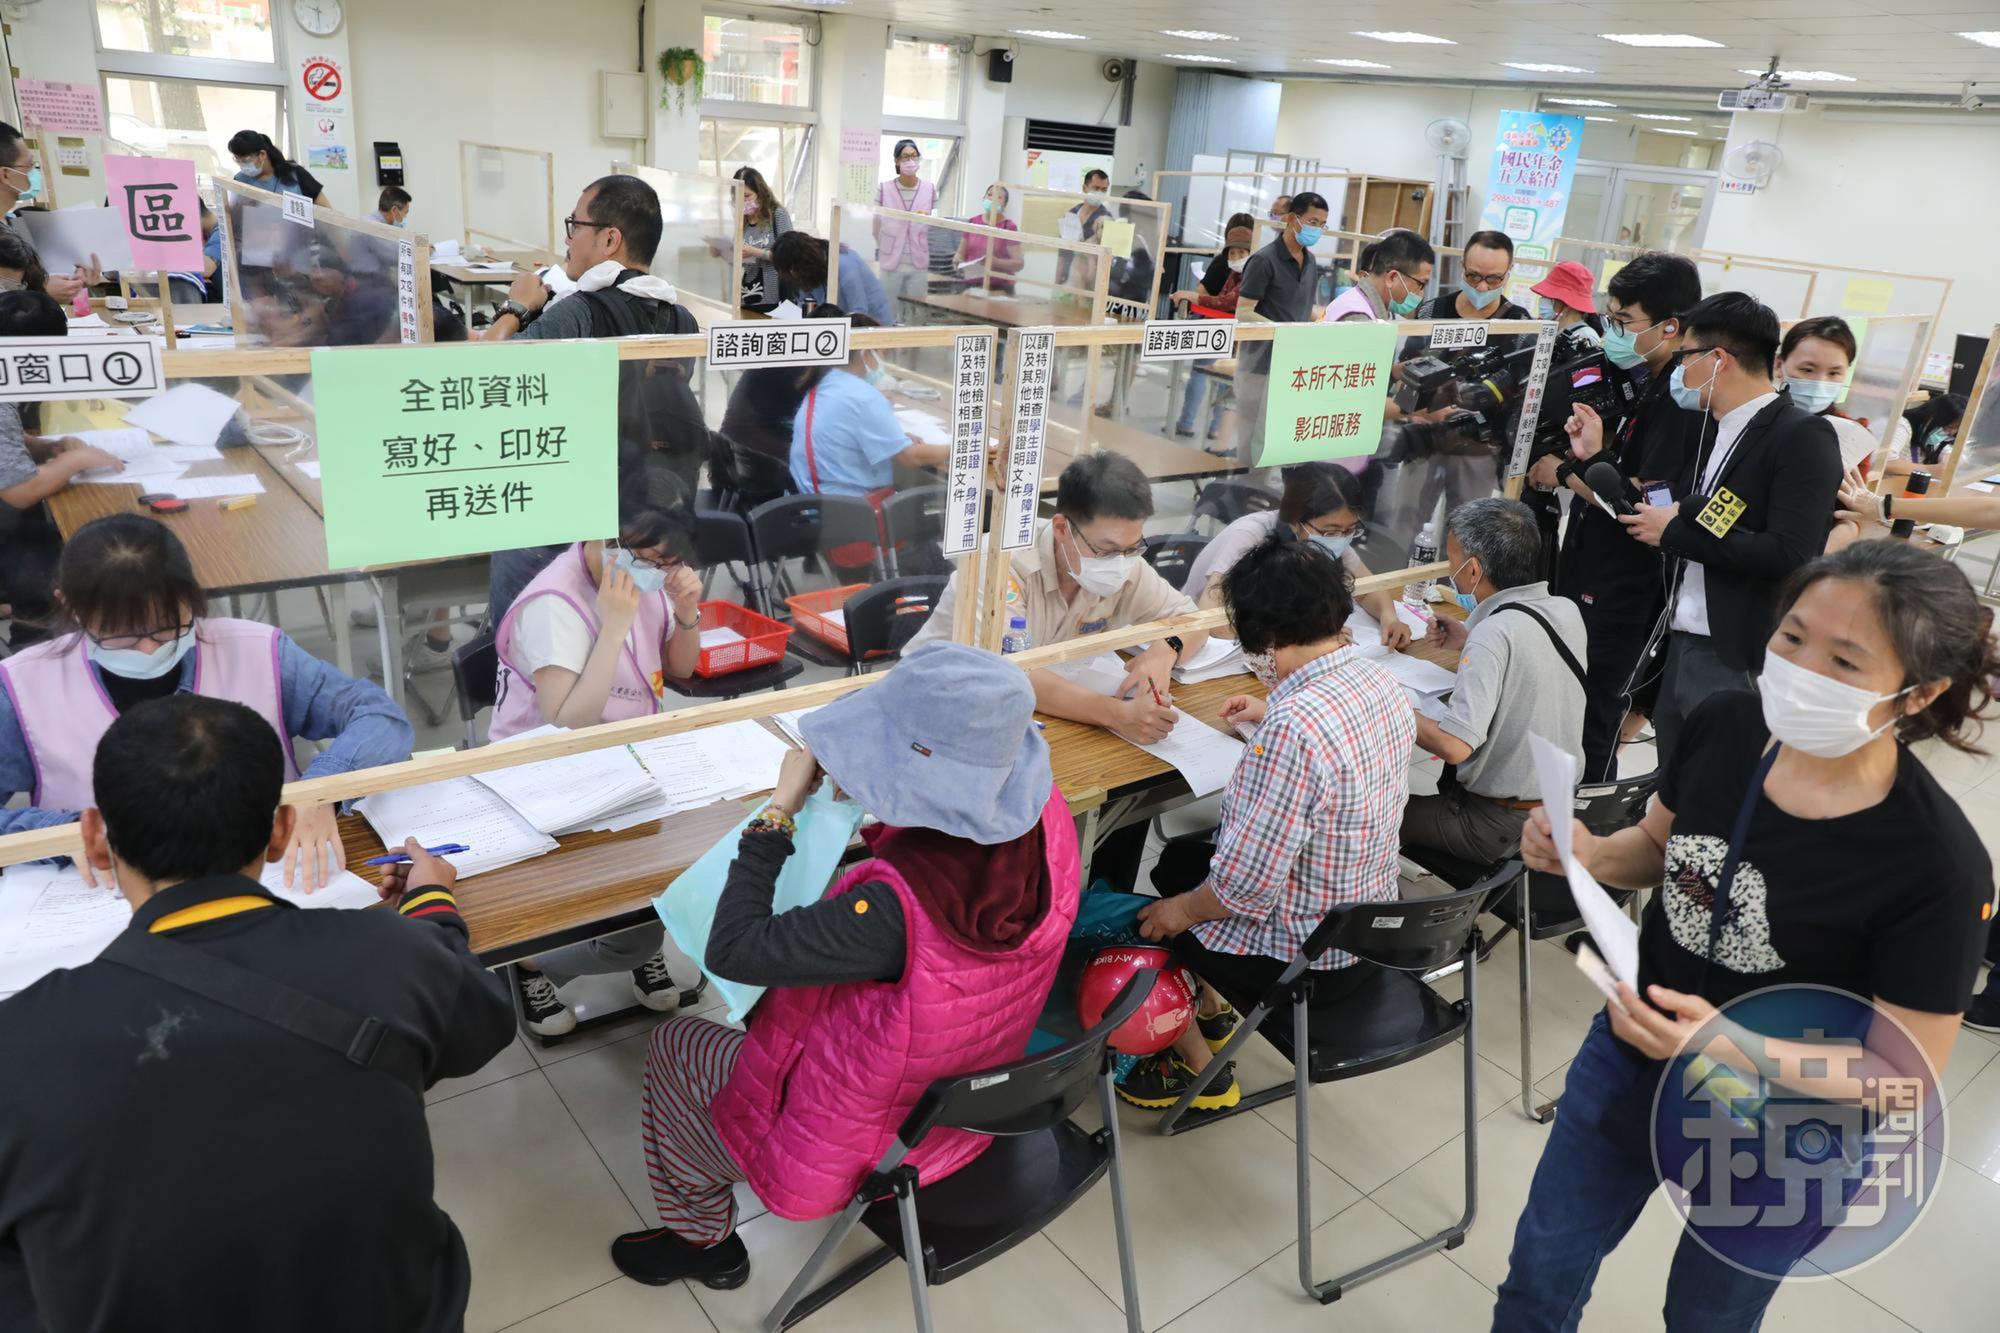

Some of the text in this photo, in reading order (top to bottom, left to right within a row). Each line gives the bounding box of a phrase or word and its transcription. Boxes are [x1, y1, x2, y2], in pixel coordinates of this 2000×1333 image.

[1499, 169, 1559, 188] 五大給付
[1500, 150, 1562, 171] 國民年金
[124, 183, 192, 242] 區
[400, 374, 550, 413] 全部資料
[1291, 362, 1377, 392] 本所不提供
[953, 338, 973, 503] 以及其他相關證明文件
[1011, 335, 1036, 500] 以及其他相關證明文件
[1294, 411, 1361, 443] 影印服務
[382, 426, 568, 470] 寫好、印好
[962, 338, 987, 548] 請特別檢查學生證、身障手冊
[1018, 335, 1049, 545] 請特別檢查學生證、身障手冊
[425, 481, 534, 521] 再送件
[1115, 954, 1133, 962] MY
